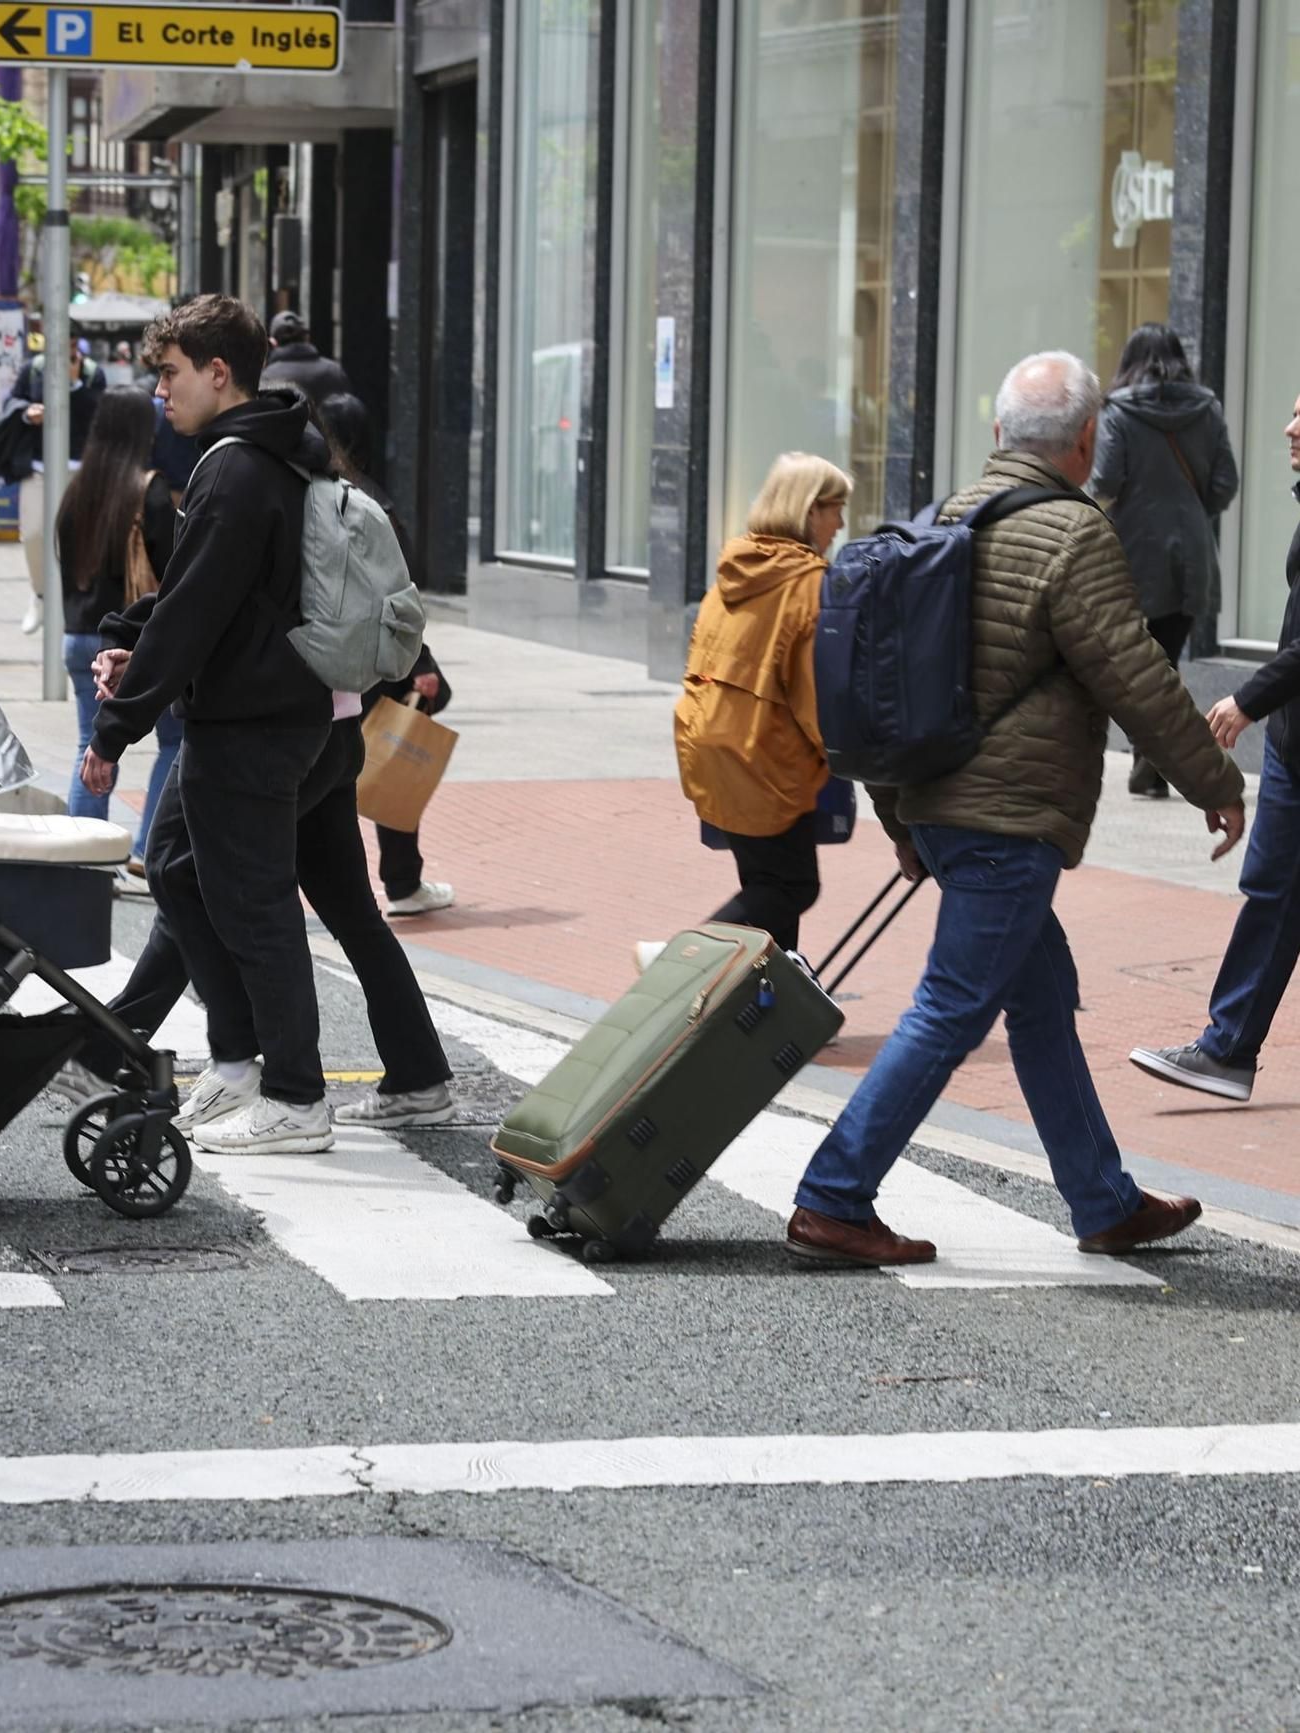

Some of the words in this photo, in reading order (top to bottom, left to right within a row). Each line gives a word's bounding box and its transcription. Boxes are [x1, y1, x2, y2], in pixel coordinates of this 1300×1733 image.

[55, 14, 86, 52] P
[117, 21, 144, 43] El
[161, 23, 235, 46] Corte
[251, 26, 332, 52] Inglés
